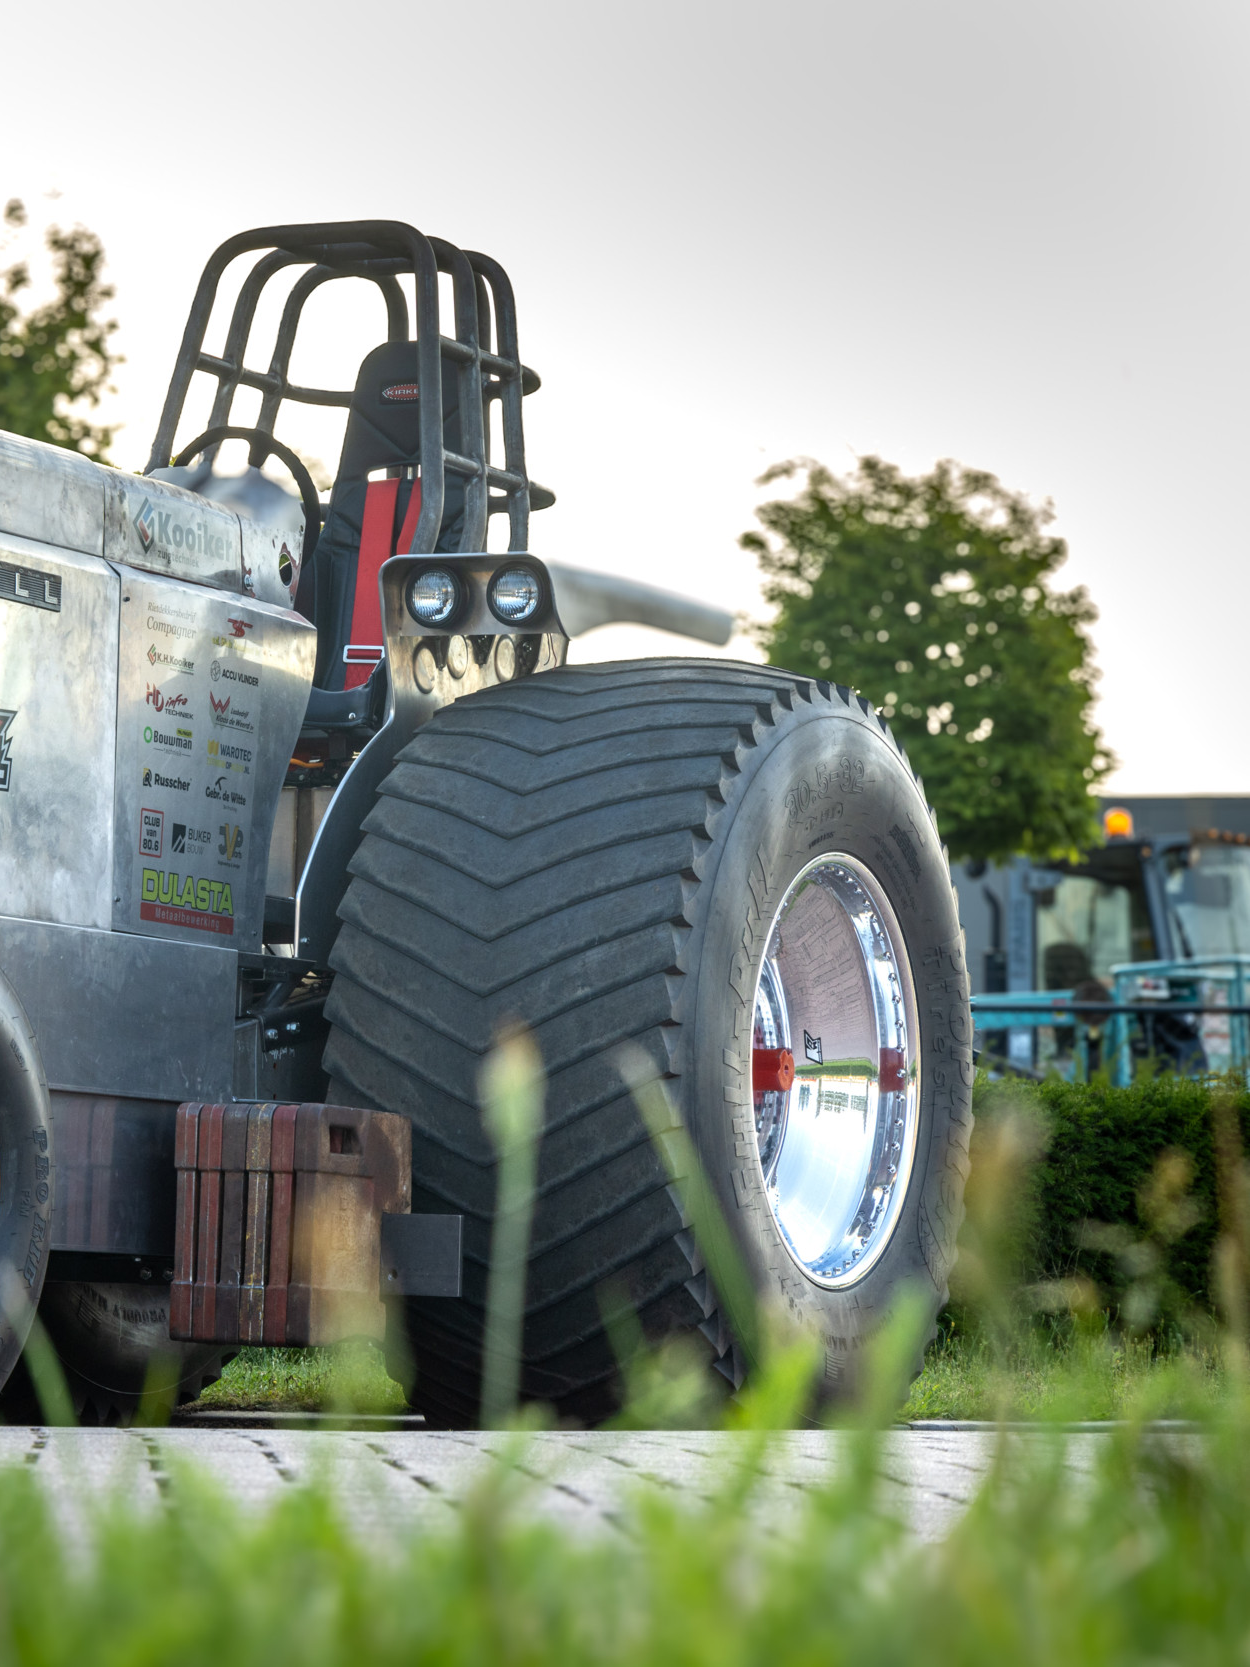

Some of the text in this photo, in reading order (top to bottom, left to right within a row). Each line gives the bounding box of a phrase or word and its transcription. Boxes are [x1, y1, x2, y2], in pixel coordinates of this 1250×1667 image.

[157, 511, 233, 561] Kooiker
[157, 548, 199, 568] zuigtechniek
[146, 616, 197, 640] Compagner
[222, 669, 237, 682] ACCU
[153, 730, 192, 750] Bouwman
[220, 743, 252, 761] WAROTEC
[154, 773, 190, 792] Russcher
[205, 786, 221, 800] Gebr.
[222, 790, 229, 802] de
[144, 815, 160, 828] CLUB
[146, 829, 157, 838] van
[143, 839, 159, 851] 80.6
[141, 867, 234, 916] DULASTA
[155, 907, 220, 931] Metaalbewerking
